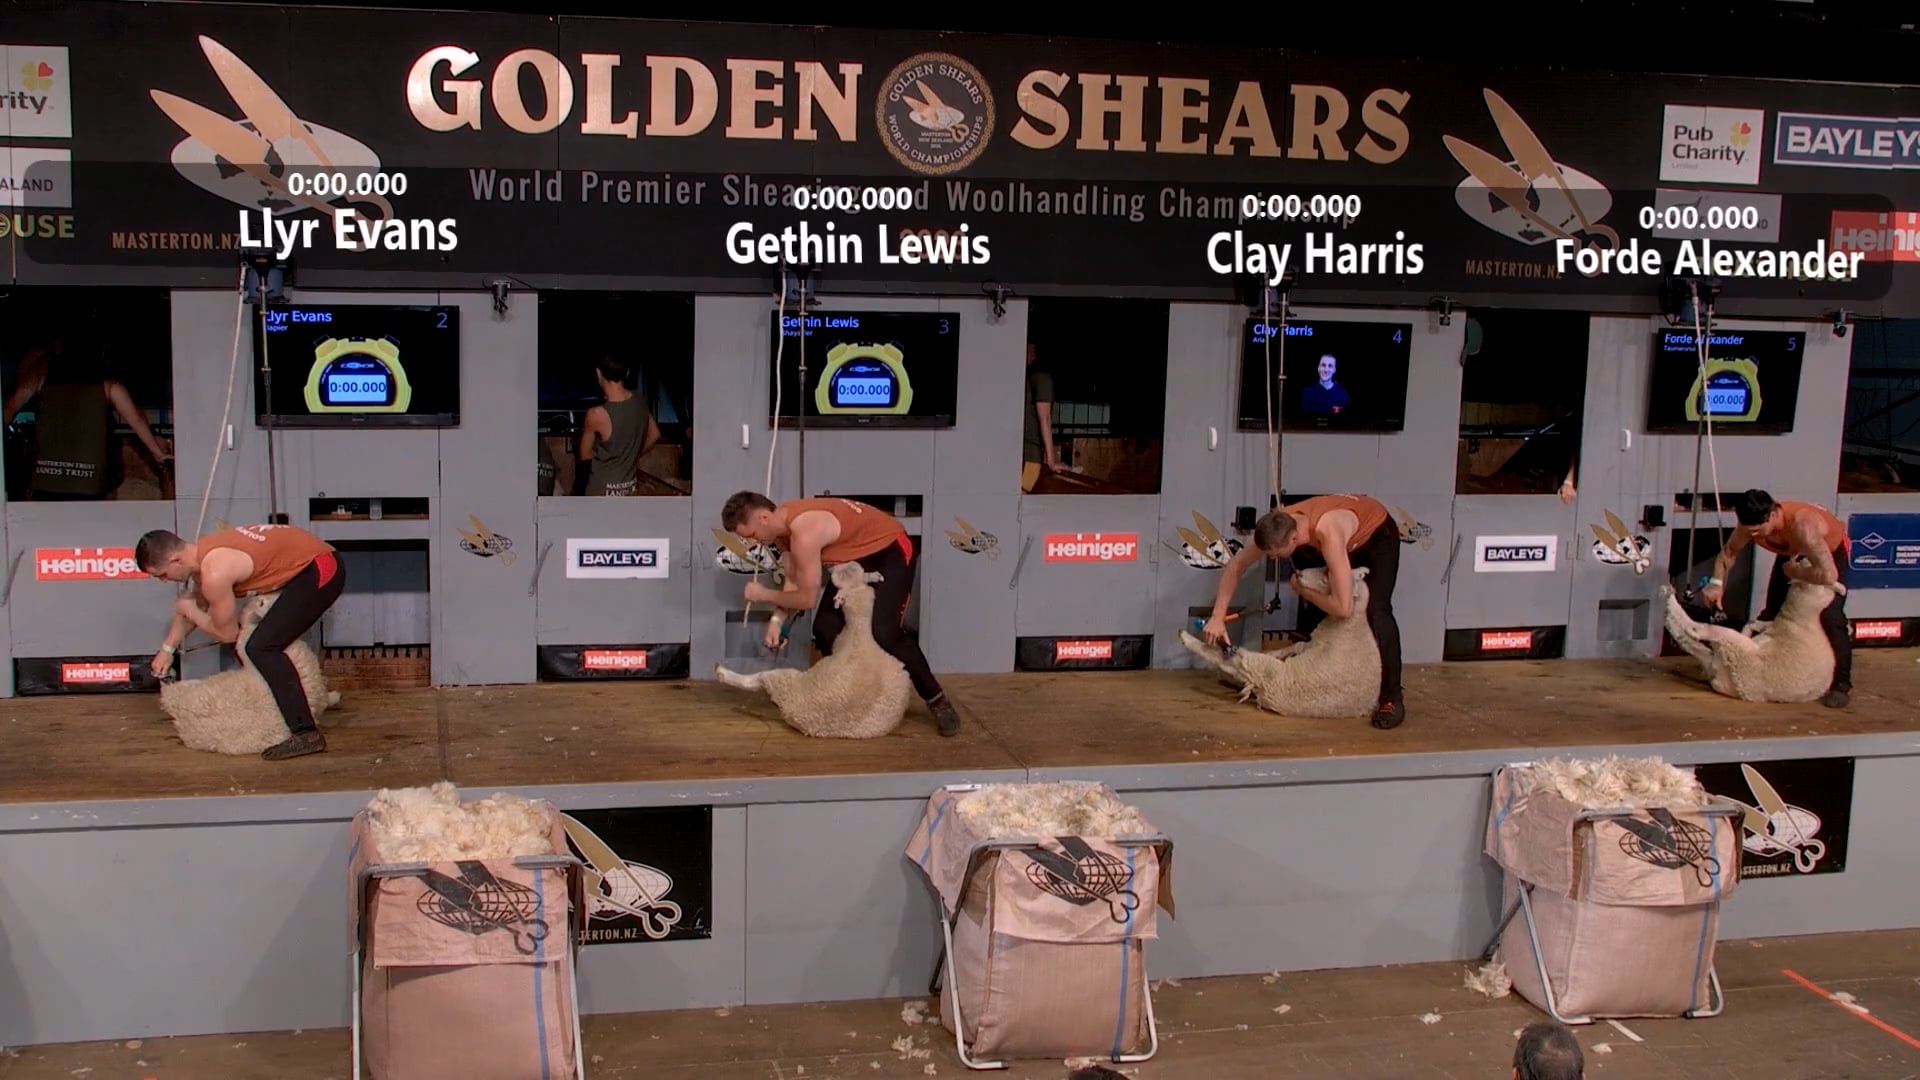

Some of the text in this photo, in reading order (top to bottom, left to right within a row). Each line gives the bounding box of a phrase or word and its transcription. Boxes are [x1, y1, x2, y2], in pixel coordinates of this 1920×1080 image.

[890, 64, 982, 104] GOLDEN SHEARS
[406, 45, 1412, 165] GOLDEN SHEARS
[889, 114, 984, 164] WORLD CHAMPIONSHIPS
[1674, 125, 1713, 141] Pub
[1787, 125, 1920, 157] BAYLEY
[1672, 144, 1745, 165] Charity
[470, 169, 562, 202] World
[581, 171, 706, 204] Premier
[946, 181, 1145, 222] Woolhandling
[1834, 213, 1920, 258] Heini
[292, 310, 332, 322] Evans
[437, 313, 448, 328] 2
[825, 316, 859, 328] Lewis
[939, 320, 949, 334] 3
[1253, 323, 1278, 337] Clay
[1393, 330, 1402, 344] 4
[1665, 333, 1744, 345] Forde Alxander
[1788, 338, 1796, 351] 5
[330, 382, 386, 393] 0:00.000
[839, 385, 890, 395] 0:00.000
[1048, 534, 1136, 560] Heiniger
[1487, 548, 1544, 560] BAYLEYS
[582, 552, 653, 565] BAYLEYS
[1856, 623, 1898, 635] Heiniger
[1482, 632, 1530, 647] Heiniger
[1058, 641, 1110, 657] Heiniger
[587, 651, 644, 666] Heiniger
[66, 663, 128, 680] Heiniger
[1740, 864, 1791, 875] STERTON.NZ
